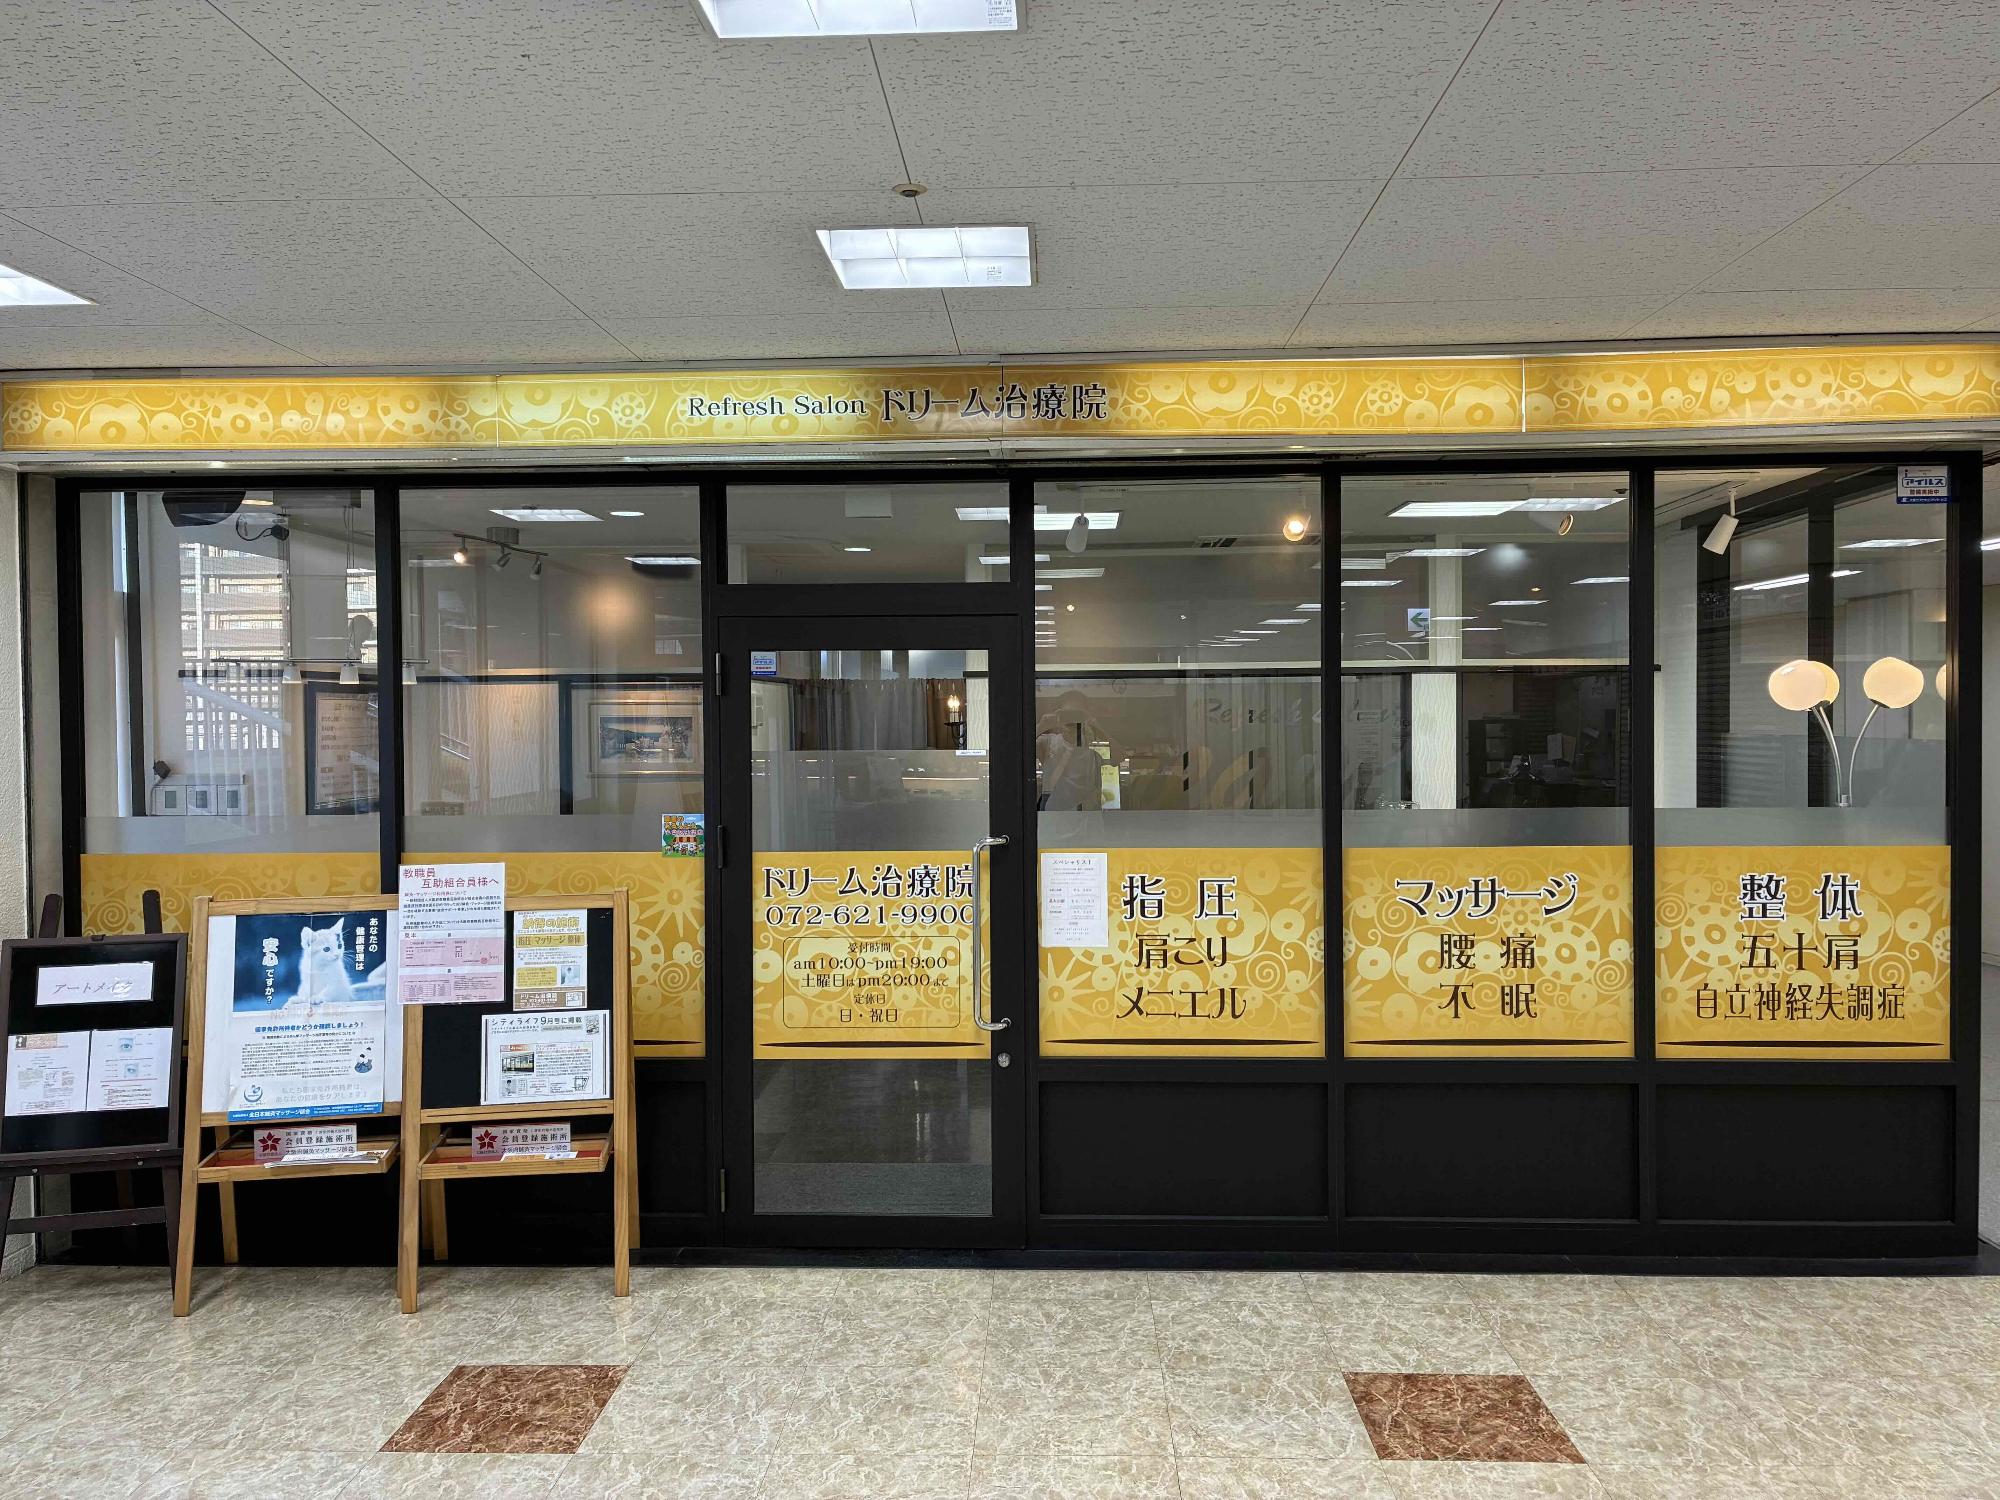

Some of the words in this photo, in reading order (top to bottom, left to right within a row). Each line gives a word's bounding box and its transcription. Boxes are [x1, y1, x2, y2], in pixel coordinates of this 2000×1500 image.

[688, 395, 785, 418] Refresh
[794, 393, 867, 416] Salon
[880, 383, 1108, 422] ドリーム治療院
[1904, 478, 1944, 487] アイルス
[403, 868, 435, 878] 教職員
[421, 876, 499, 889] 互助組合員様へ
[763, 864, 973, 899] ドリーム治療院
[1122, 874, 1238, 921] 指圧
[1395, 872, 1580, 919] マッサージ
[1738, 872, 1863, 921] 整体
[765, 904, 974, 926] 072-621-9900
[355, 926, 365, 971] 健康管理は
[369, 917, 379, 953] あなたの
[534, 935, 566, 945] マッサージ
[847, 942, 892, 953] 受付時間
[1134, 933, 1227, 969] 肩こり
[1438, 932, 1537, 970] 腰痛
[1739, 932, 1862, 971] 五十肩
[840, 1008, 898, 1023] 日・祝日
[853, 993, 886, 1004] 定休日
[1116, 987, 1247, 1020] メニエル
[1438, 982, 1538, 1019] 不眠
[1696, 982, 1905, 1021] 自立神経失調症
[491, 1016, 582, 1026] シティライフ9月号に掲載
[285, 1134, 353, 1145] 会員登録施術所
[502, 1133, 568, 1143] 会員登録施術所
